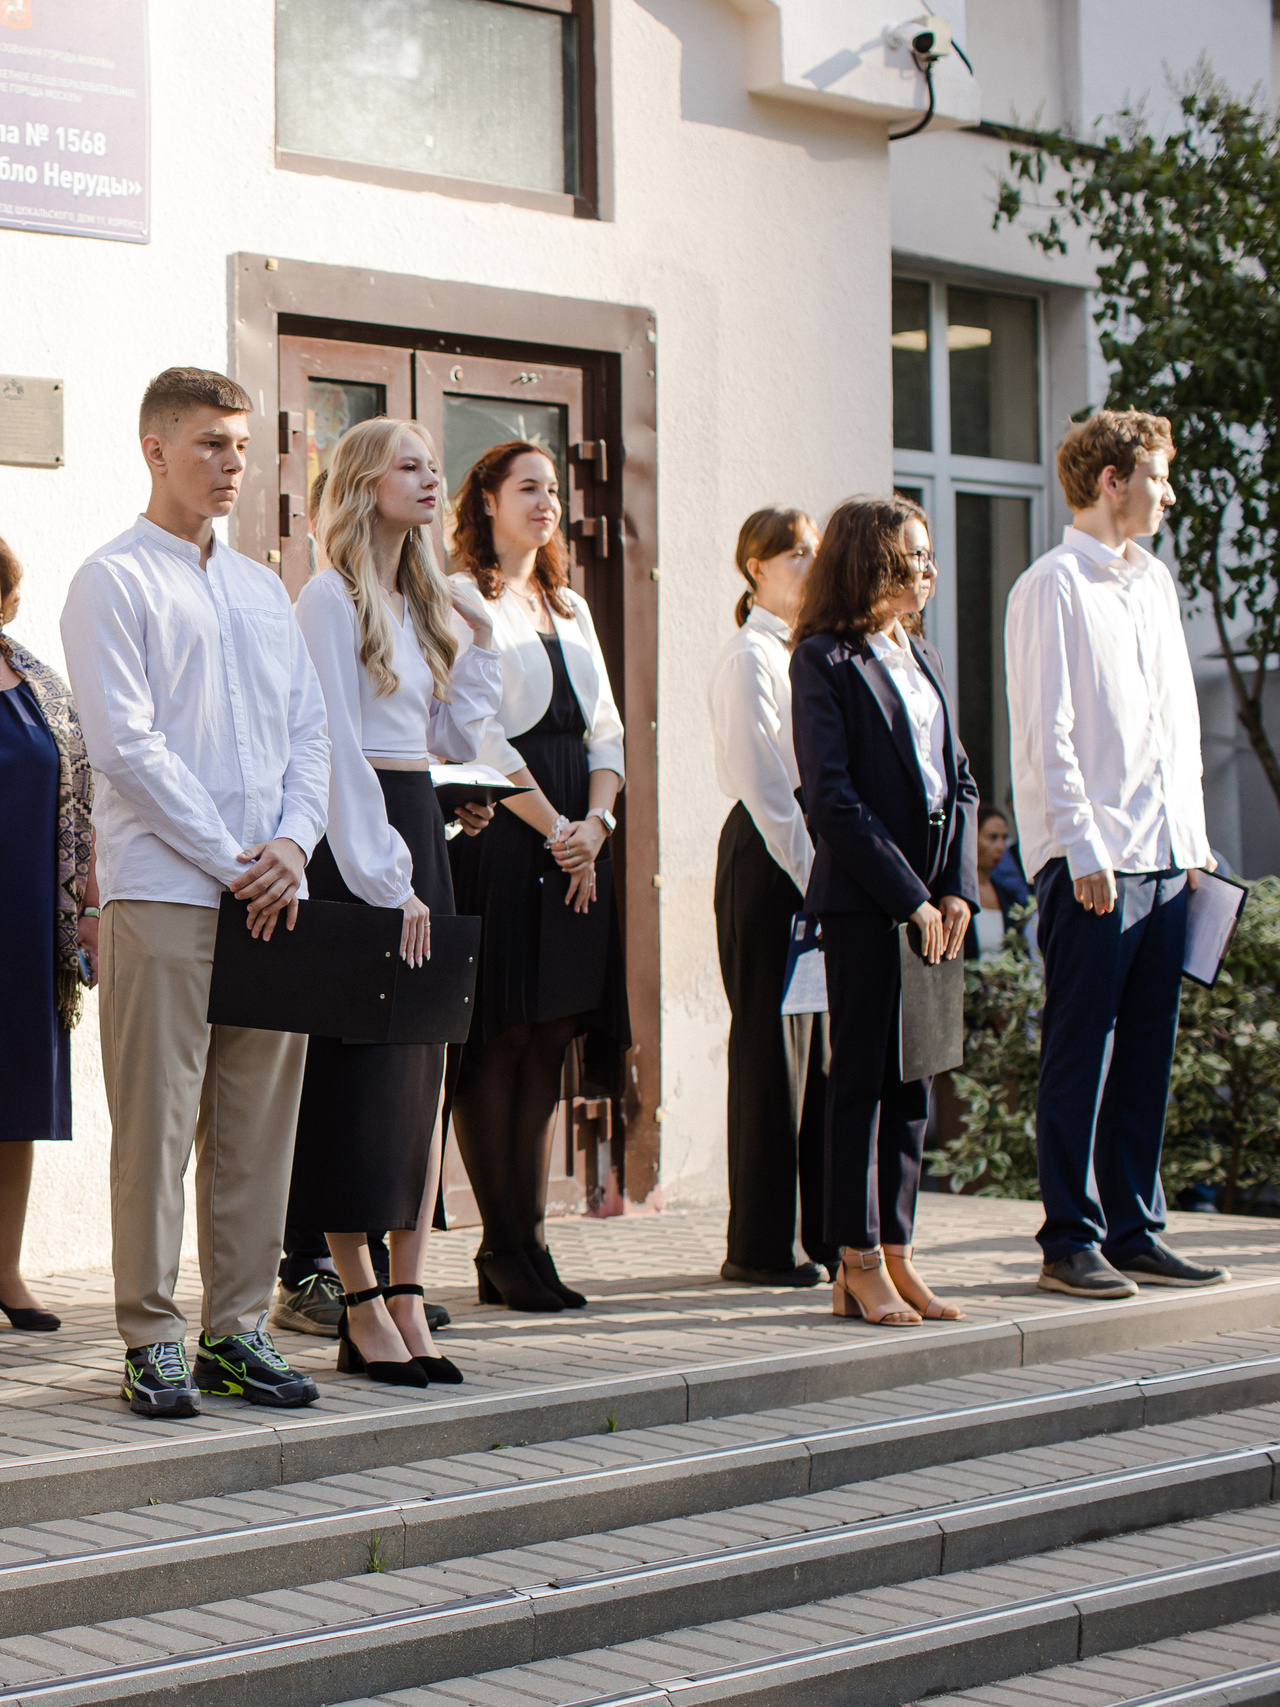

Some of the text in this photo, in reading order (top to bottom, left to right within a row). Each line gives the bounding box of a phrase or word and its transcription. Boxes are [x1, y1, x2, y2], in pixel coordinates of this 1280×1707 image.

[24, 121, 50, 148] №
[55, 126, 107, 156] 1568
[43, 161, 143, 198] Неруды»
